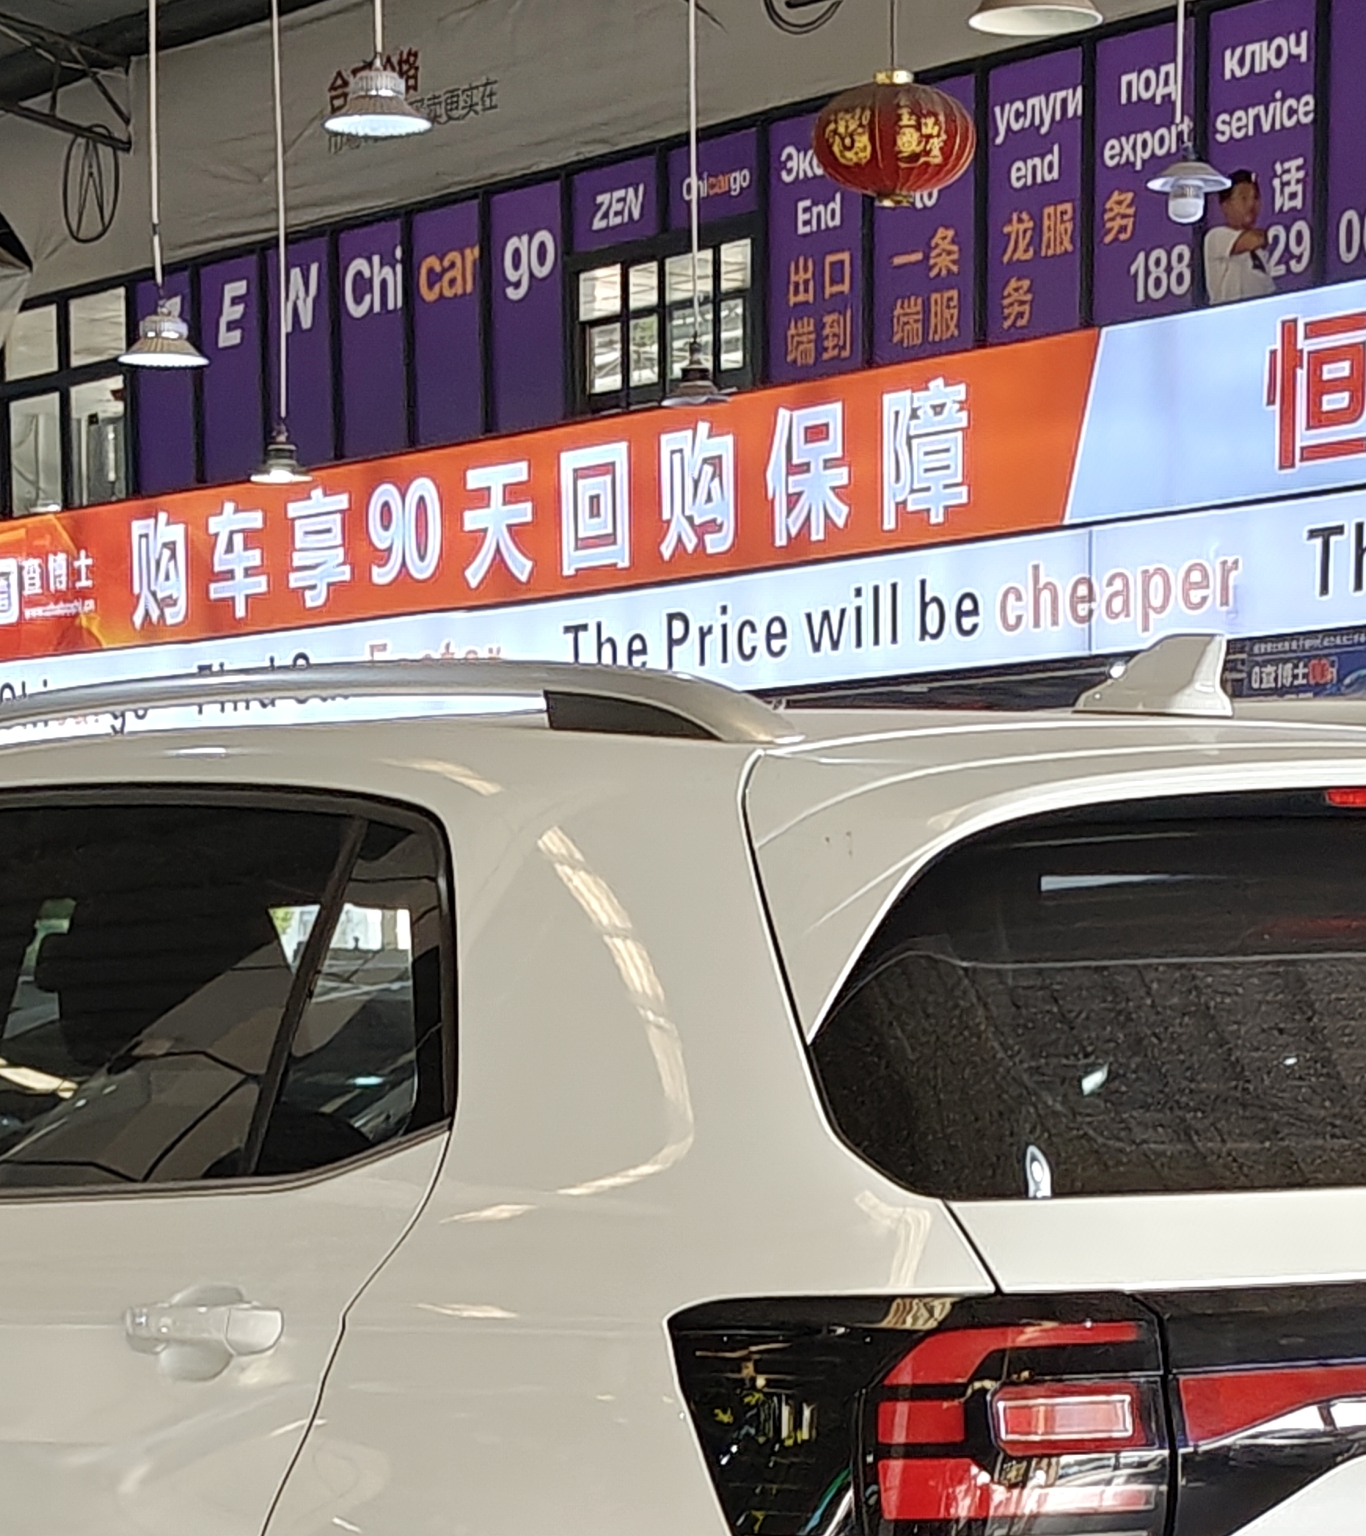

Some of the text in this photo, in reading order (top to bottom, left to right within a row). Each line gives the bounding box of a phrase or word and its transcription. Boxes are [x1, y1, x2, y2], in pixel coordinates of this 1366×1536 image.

[994, 85, 1083, 145] услуги
[1120, 63, 1179, 104] под
[1224, 30, 1308, 81] ключ
[591, 182, 645, 231] ZEN
[797, 191, 842, 235] End
[1010, 144, 1059, 189] end
[1215, 90, 1315, 143] service
[789, 190, 1136, 307] 出口 一条 龙服 务
[1130, 244, 1191, 303] 188
[787, 276, 1033, 367] 端到 端服 务
[132, 378, 969, 631] 购车享90天回购保障
[562, 556, 1241, 671] The Price will be cheaper
